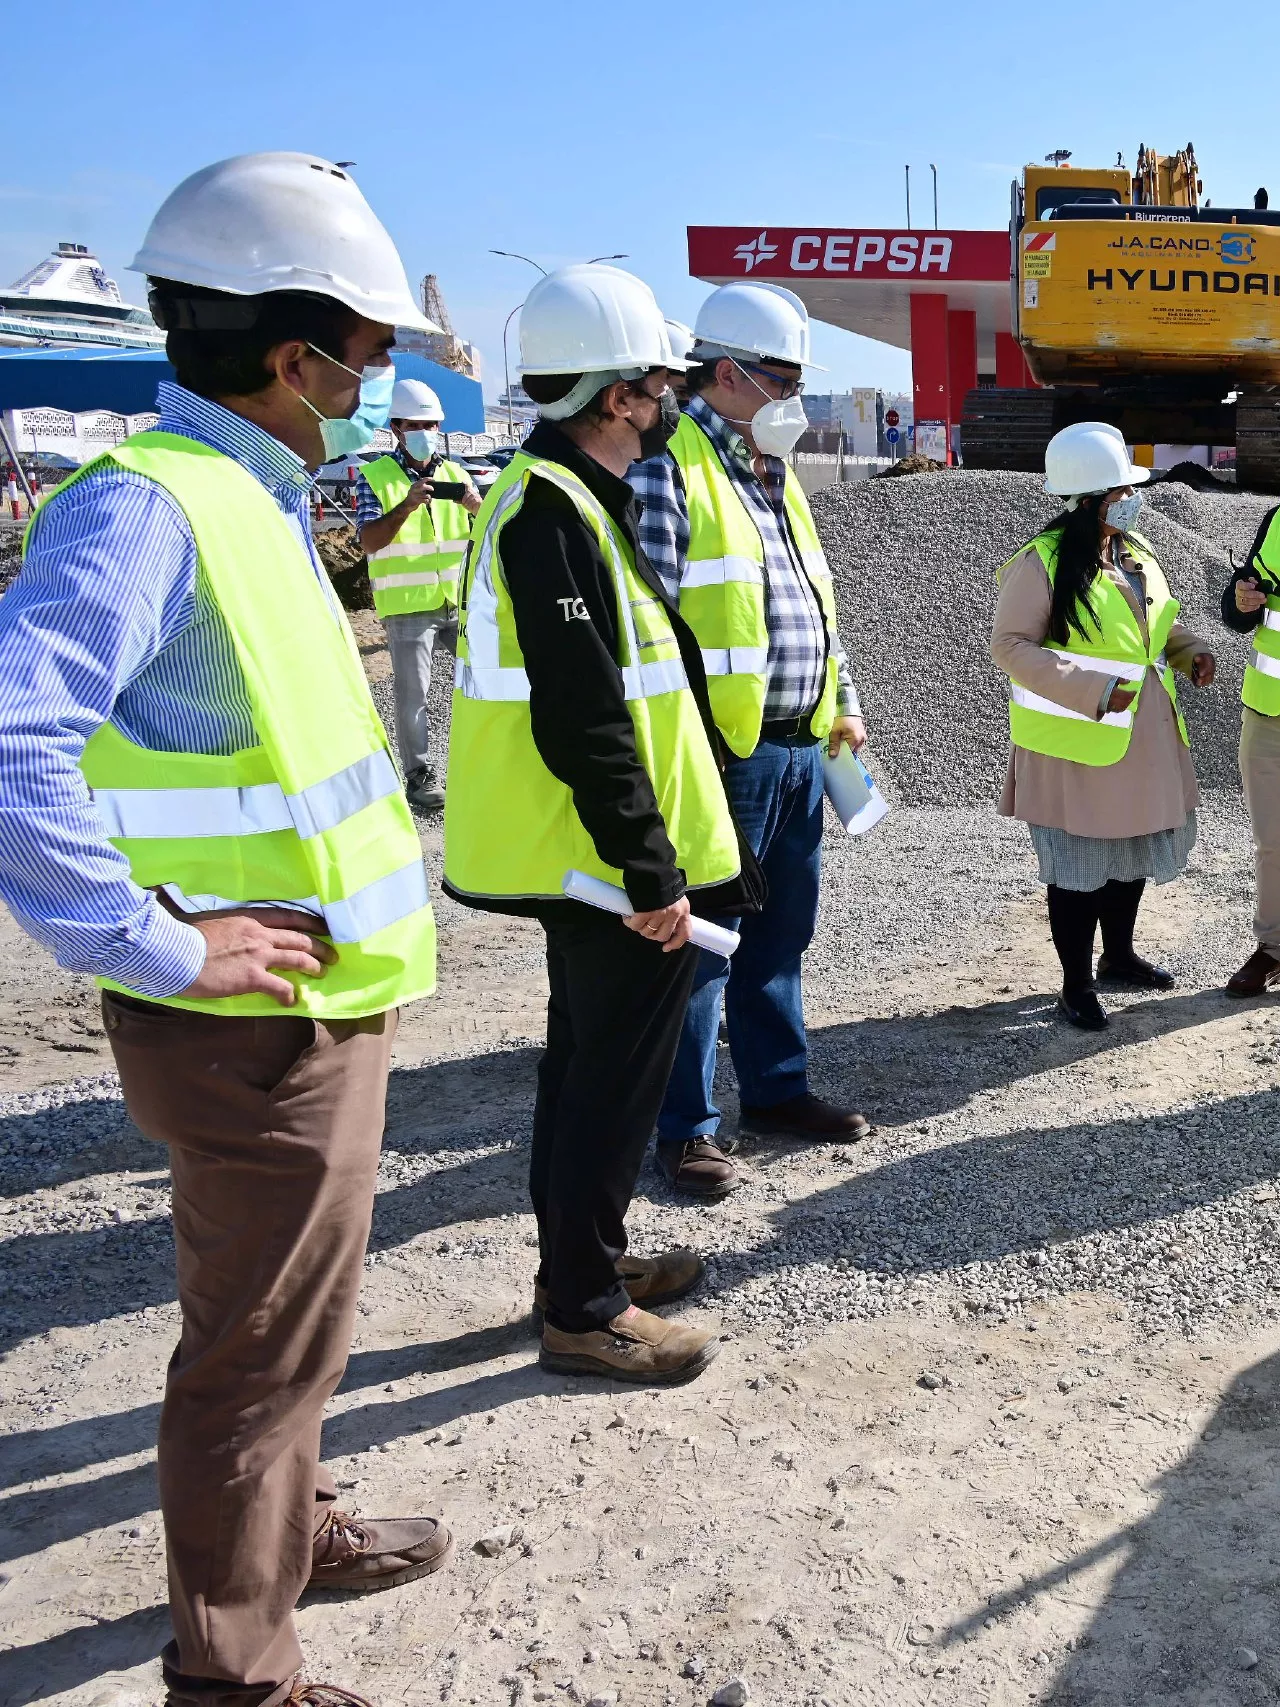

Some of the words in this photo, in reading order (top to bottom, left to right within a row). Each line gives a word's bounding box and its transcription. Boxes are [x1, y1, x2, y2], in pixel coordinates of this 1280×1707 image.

[1135, 212, 1191, 222] Biurrarena
[789, 235, 953, 272] CEPSA
[1087, 268, 1280, 296] HYUNDAI
[557, 598, 591, 621] TG
